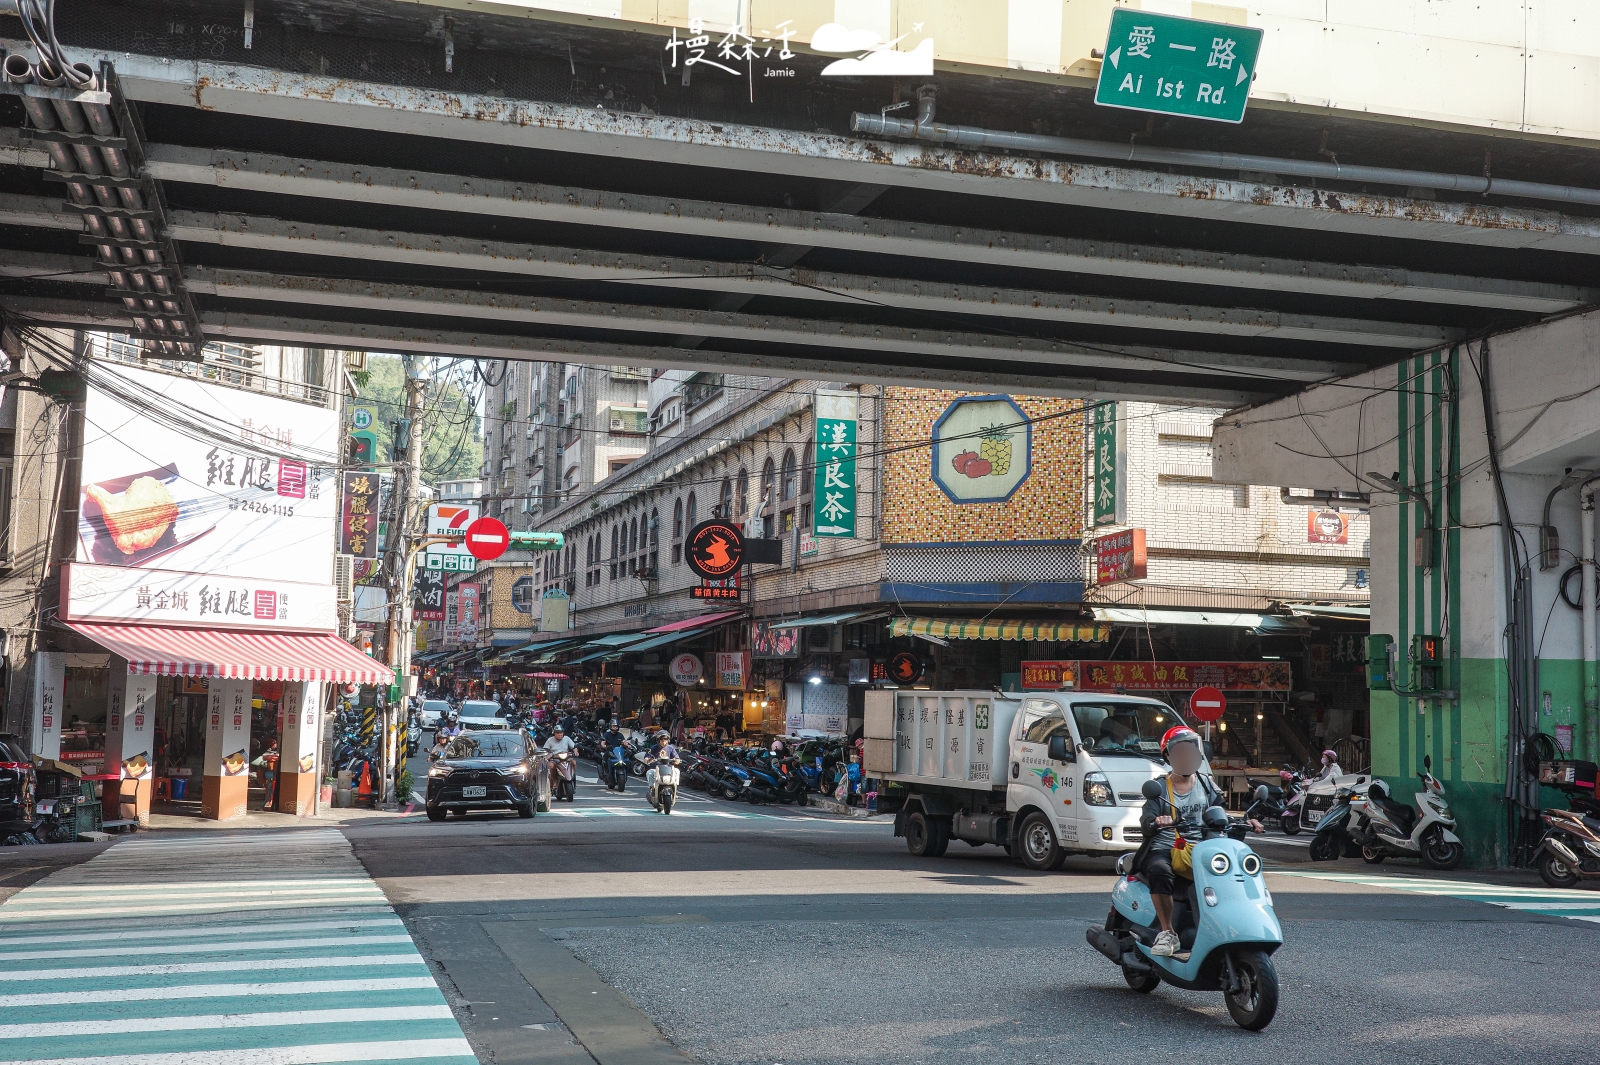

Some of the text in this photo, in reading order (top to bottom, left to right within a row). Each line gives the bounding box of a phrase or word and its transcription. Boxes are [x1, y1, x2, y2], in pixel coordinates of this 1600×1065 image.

[1127, 26, 1237, 70] 愛一路
[1118, 72, 1227, 105] Ai 1st Rd.
[820, 421, 852, 522] 漢良茶
[1097, 403, 1114, 511] 漢良茶
[349, 476, 373, 555] 燒臘便當
[135, 585, 189, 611] 黃金城
[279, 592, 288, 620] 便當
[1061, 777, 1073, 787] 146
